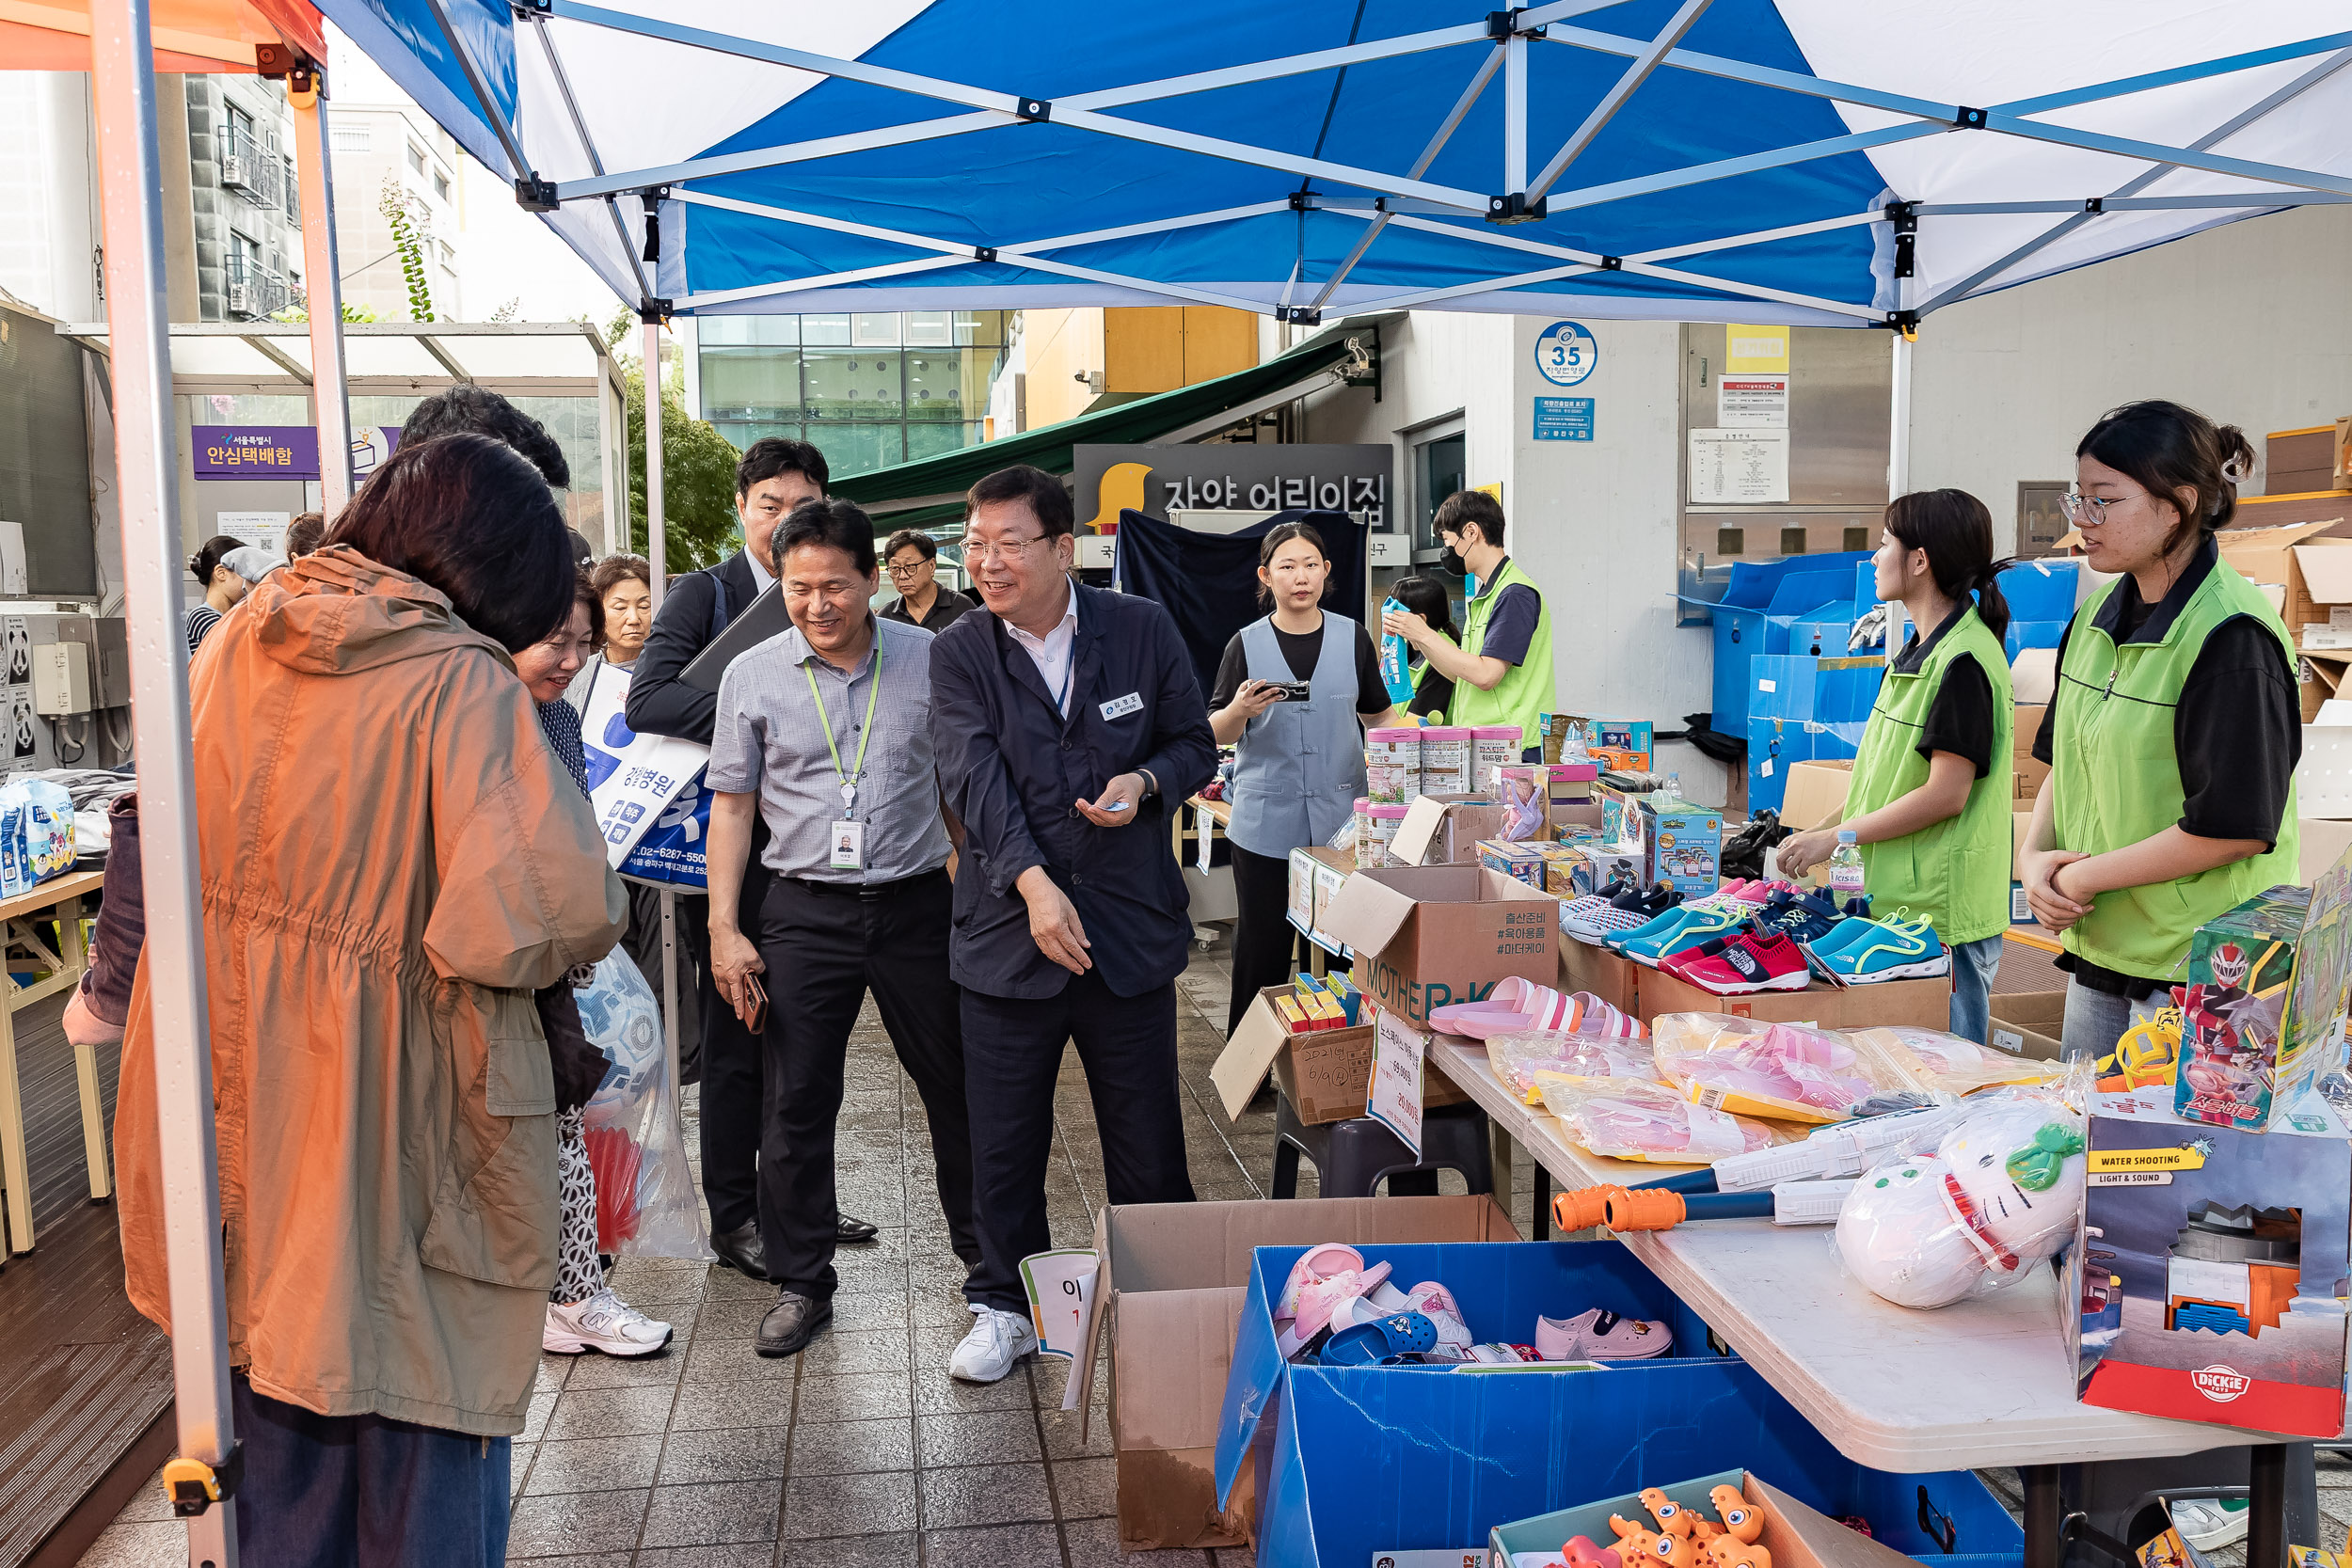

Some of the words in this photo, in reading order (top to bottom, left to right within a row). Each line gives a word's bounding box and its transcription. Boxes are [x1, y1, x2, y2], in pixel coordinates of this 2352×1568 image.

[1551, 346, 1581, 366] 35
[232, 436, 272, 445] 서울특별시
[207, 447, 293, 466] 안심택배함
[1482, 754, 1502, 763] 위드맘
[1390, 787, 1396, 800] 2
[629, 857, 644, 866] 서울
[644, 859, 664, 869] 송파구
[1505, 912, 1546, 925] 출산준비
[1497, 927, 1546, 939] #육아용품
[1497, 942, 1545, 955] #마더케이
[1727, 948, 1747, 968] NORTH
[1740, 950, 1752, 962] THE
[1727, 956, 1746, 974] FACE
[1305, 1046, 1345, 1062] 2021년
[2135, 1155, 2180, 1164] SHOOTING
[588, 1312, 612, 1330] N
